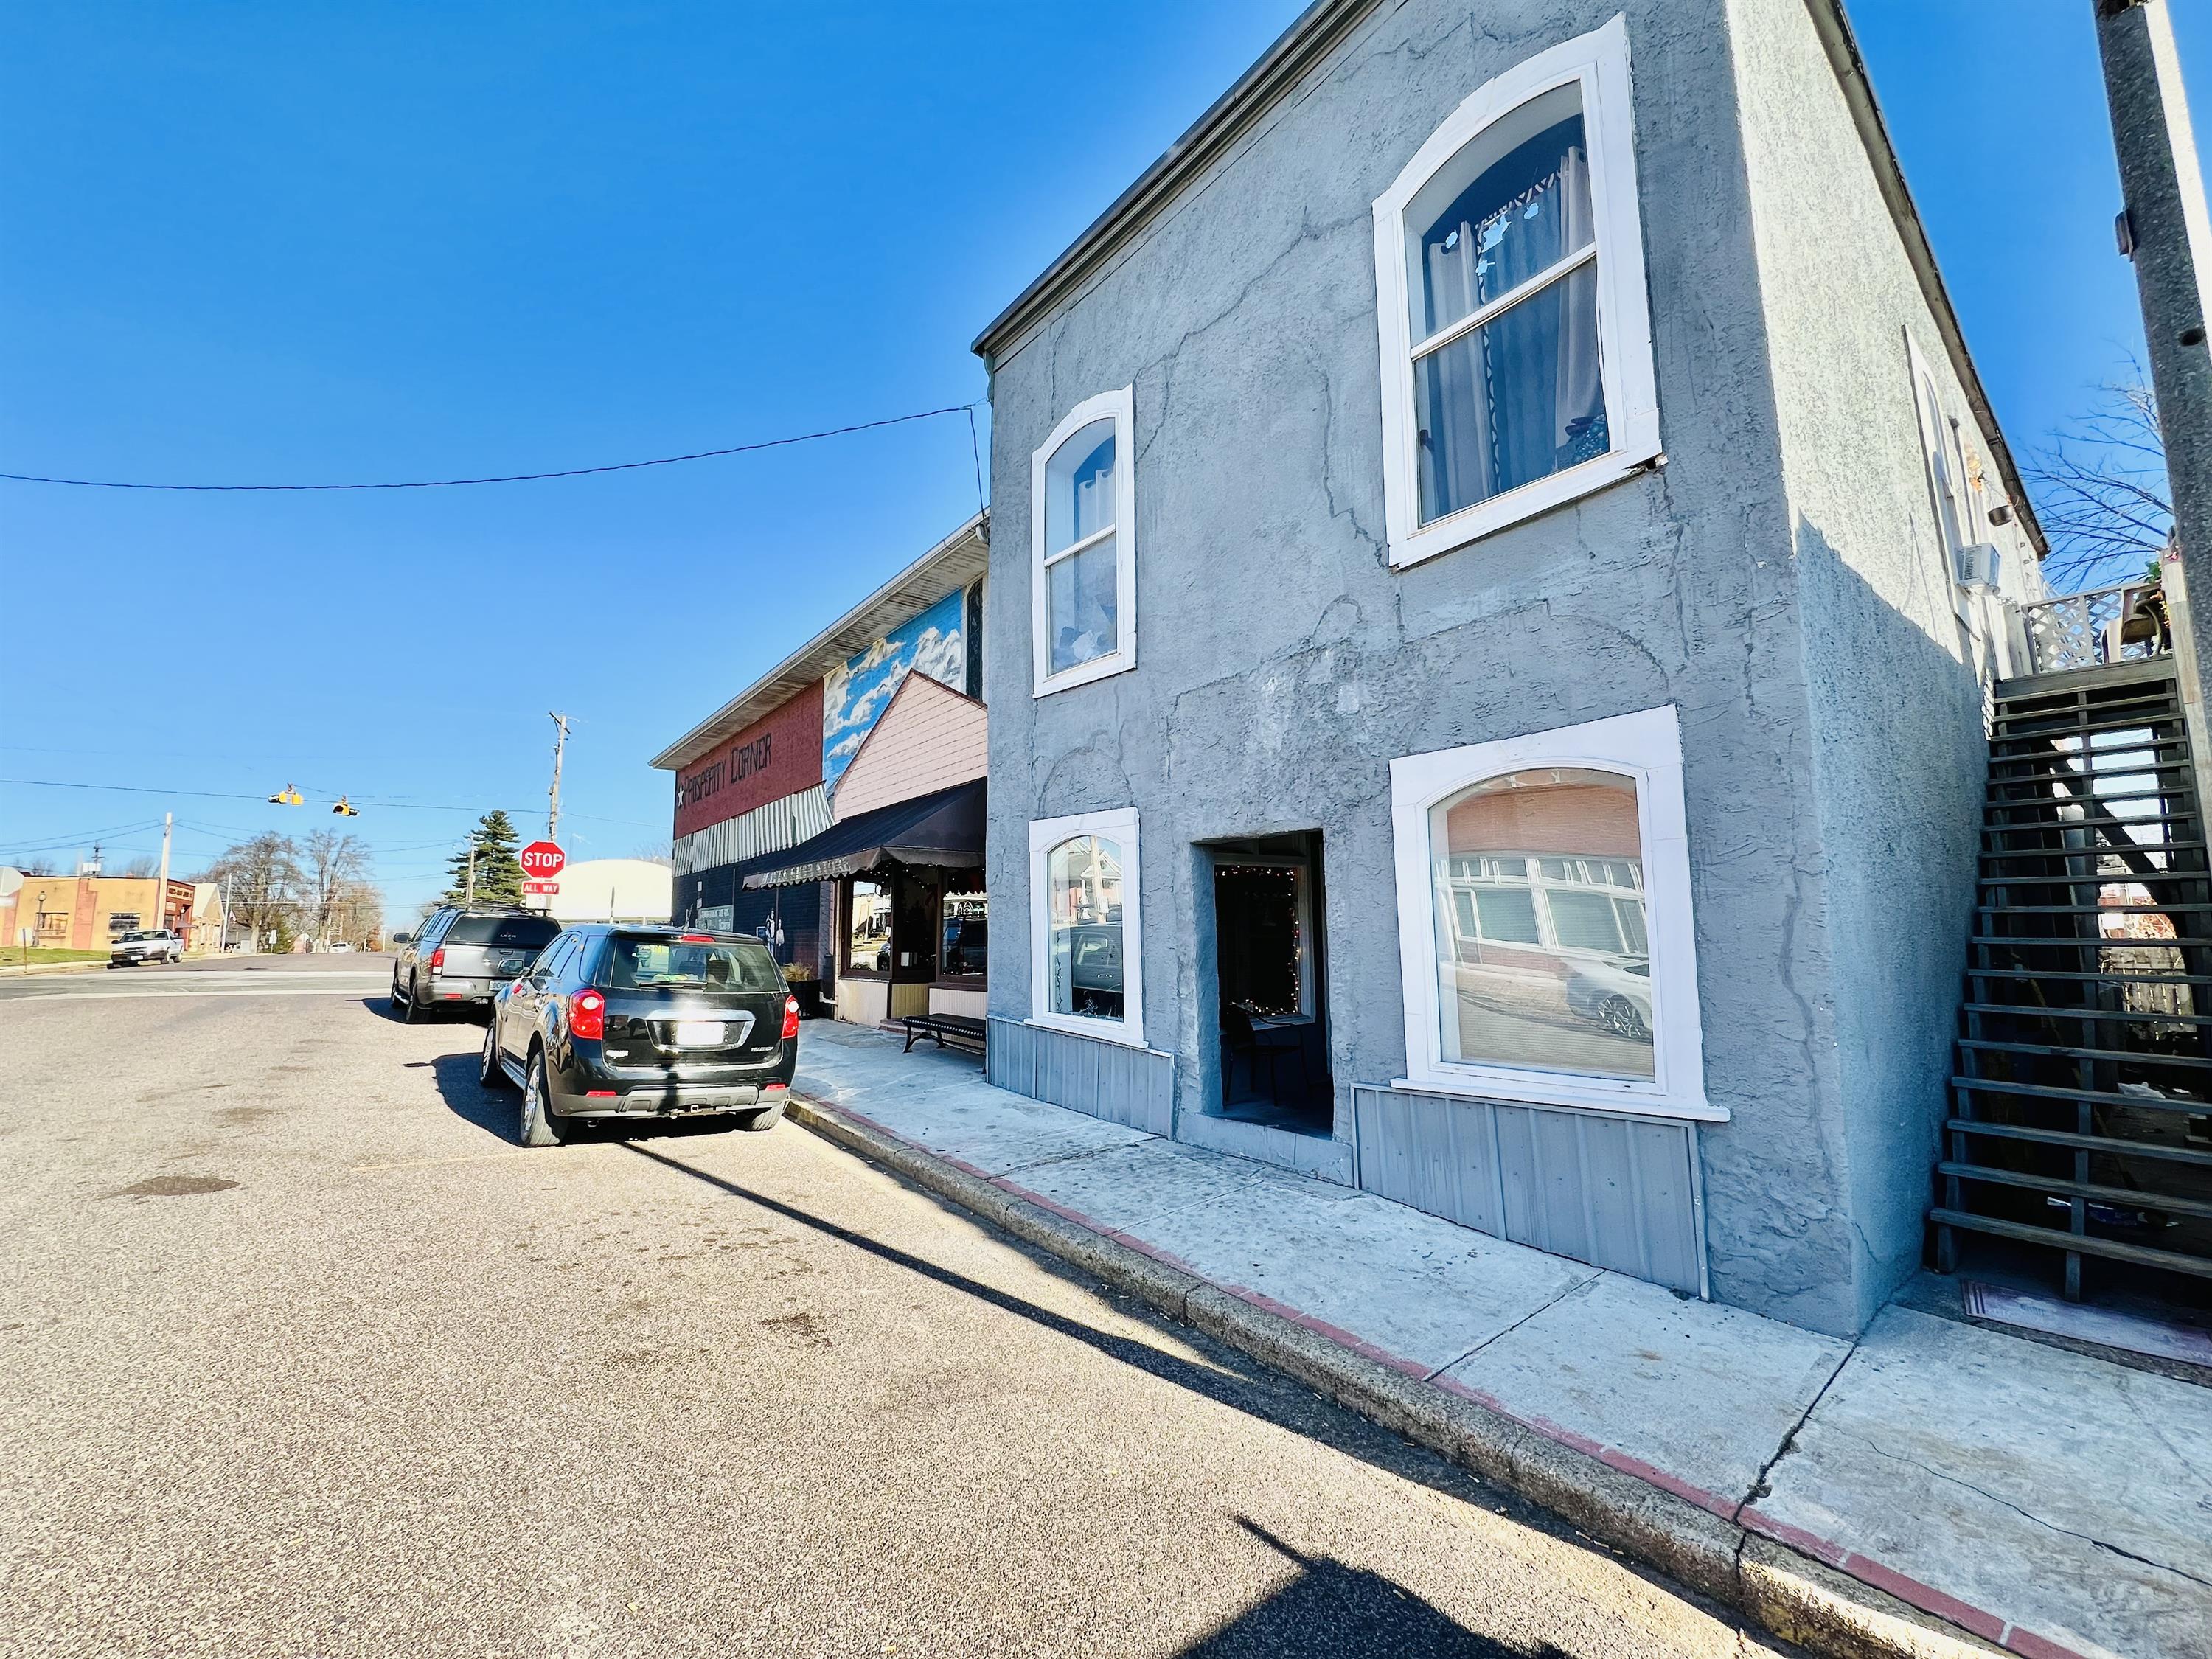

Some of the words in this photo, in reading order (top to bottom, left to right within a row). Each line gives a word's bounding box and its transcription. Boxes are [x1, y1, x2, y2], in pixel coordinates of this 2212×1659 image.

[684, 759, 726, 809] PROSPERITY
[731, 733, 771, 784] CORNER
[524, 852, 563, 867] STOP
[524, 884, 538, 892] ALL
[543, 884, 558, 893] WAY
